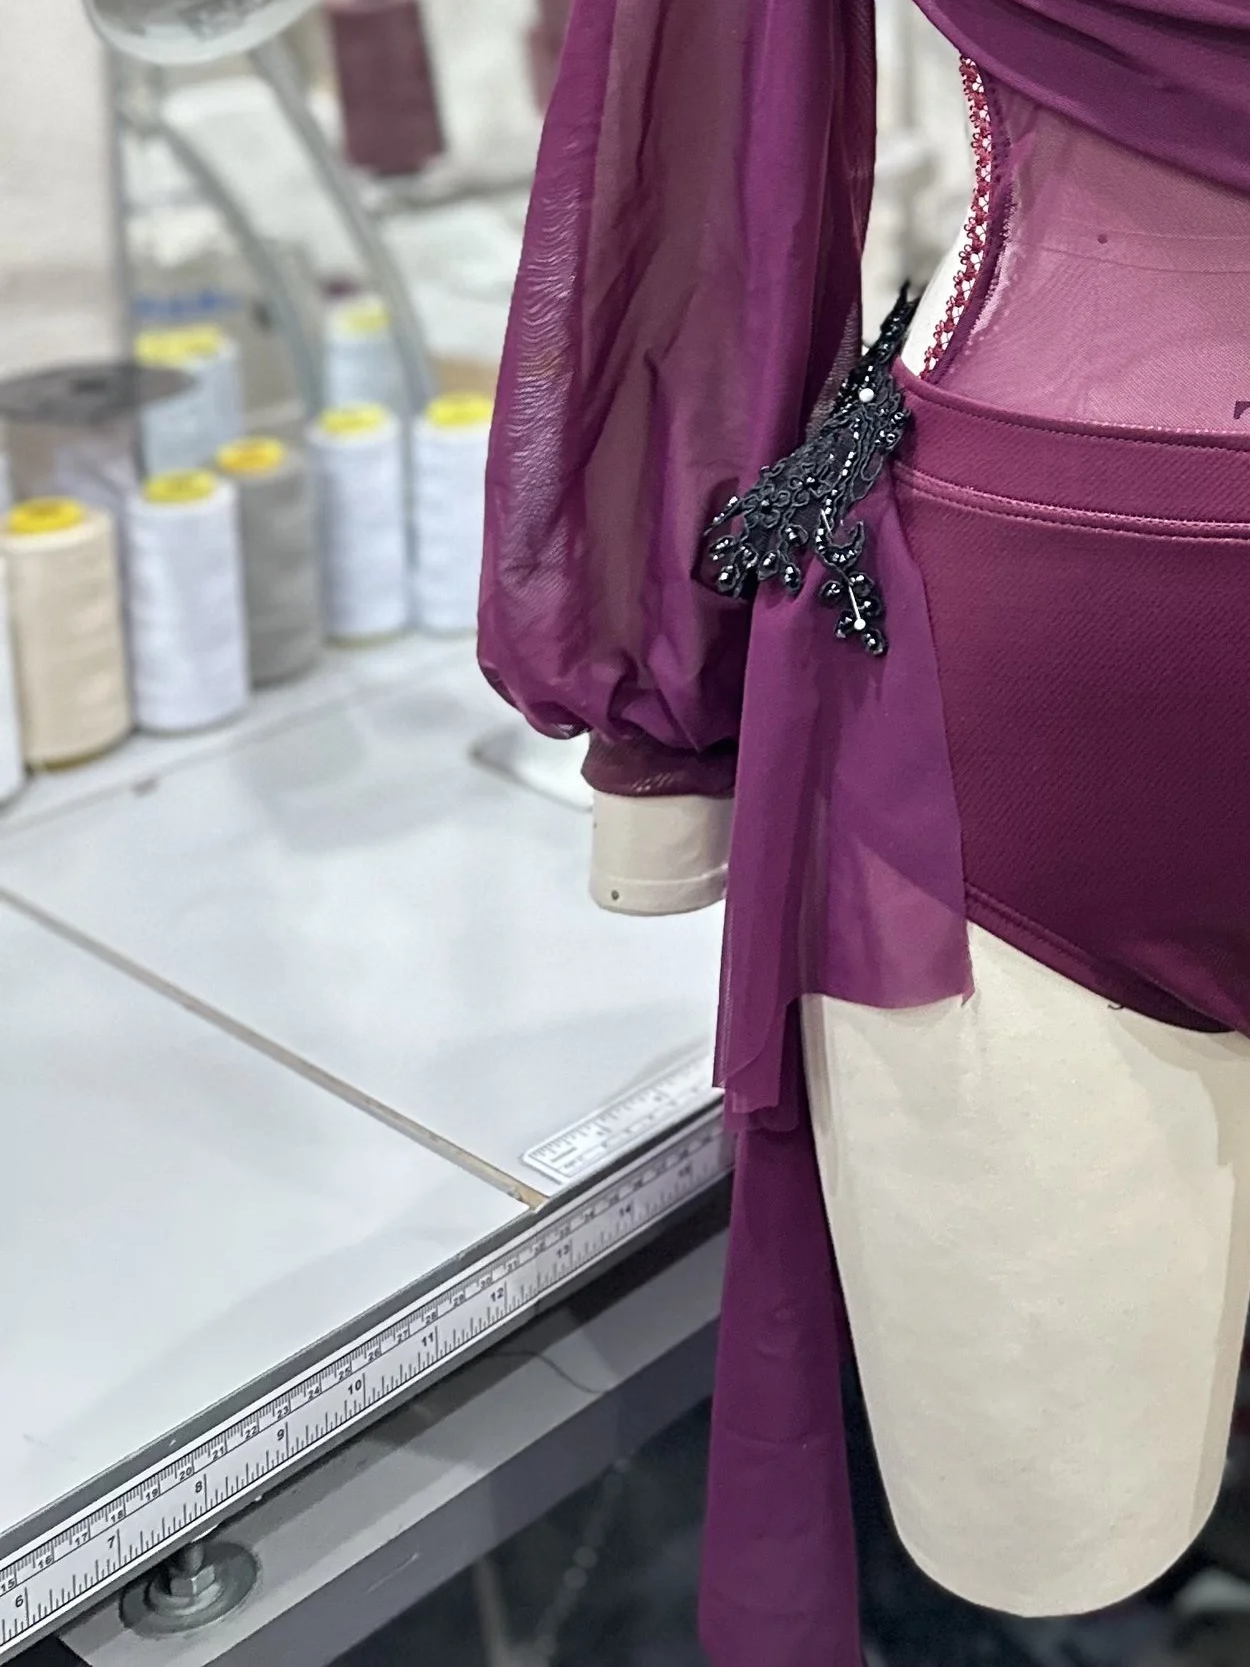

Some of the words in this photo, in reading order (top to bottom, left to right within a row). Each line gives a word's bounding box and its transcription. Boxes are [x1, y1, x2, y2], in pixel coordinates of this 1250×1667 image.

[15, 1595, 24, 1608] 6
[107, 1535, 116, 1549] 7
[194, 1480, 203, 1493] 8
[277, 1428, 285, 1441] 9
[347, 1379, 362, 1395] 10
[421, 1332, 434, 1347] 11
[490, 1287, 504, 1302] 12
[37, 1556, 53, 1570] 16
[74, 1532, 89, 1546] 17
[110, 1510, 124, 1524] 18
[145, 1488, 159, 1501] 19
[179, 1466, 193, 1480] 20
[212, 1447, 225, 1460] 21
[244, 1426, 258, 1440] 22
[277, 1406, 290, 1419] 23
[307, 1387, 320, 1400] 24
[338, 1367, 351, 1380] 25
[367, 1348, 381, 1361] 26
